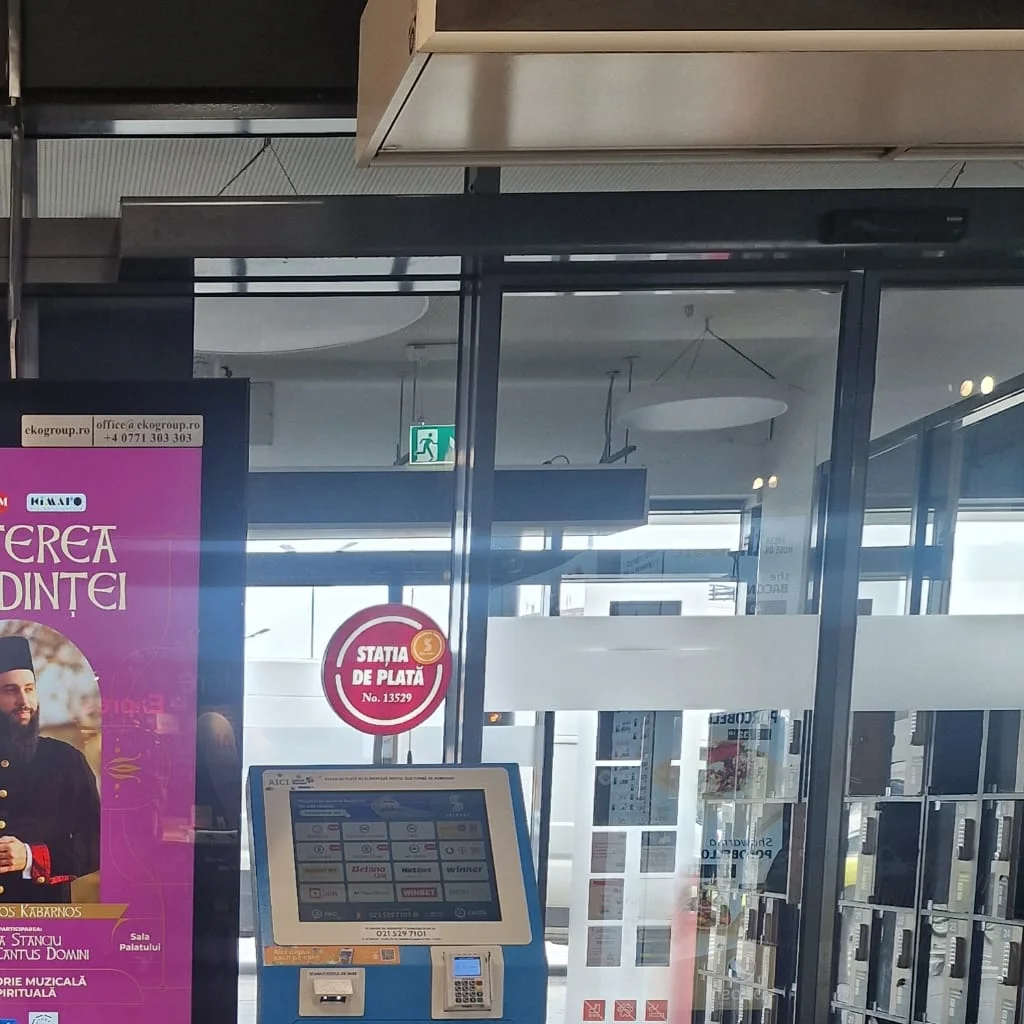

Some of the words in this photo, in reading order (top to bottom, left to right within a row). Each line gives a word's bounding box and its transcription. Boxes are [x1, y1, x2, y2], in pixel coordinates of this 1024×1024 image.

[24, 423, 91, 437] ekogroup.ro
[120, 432, 147, 444] 0771
[149, 432, 170, 444] 303
[172, 432, 193, 444] 303
[356, 645, 409, 667] STAȚIA
[351, 669, 373, 686] DE
[376, 666, 425, 686] PLATĂ
[361, 692, 381, 703] No.
[383, 692, 413, 703] 13529
[19, 903, 83, 918] KABARNOS
[10, 933, 62, 947] STANCIU
[129, 932, 150, 941] Sala
[46, 946, 90, 961] DOMINI
[119, 943, 161, 951] Palatului
[25, 974, 87, 987] MUZICALĂ
